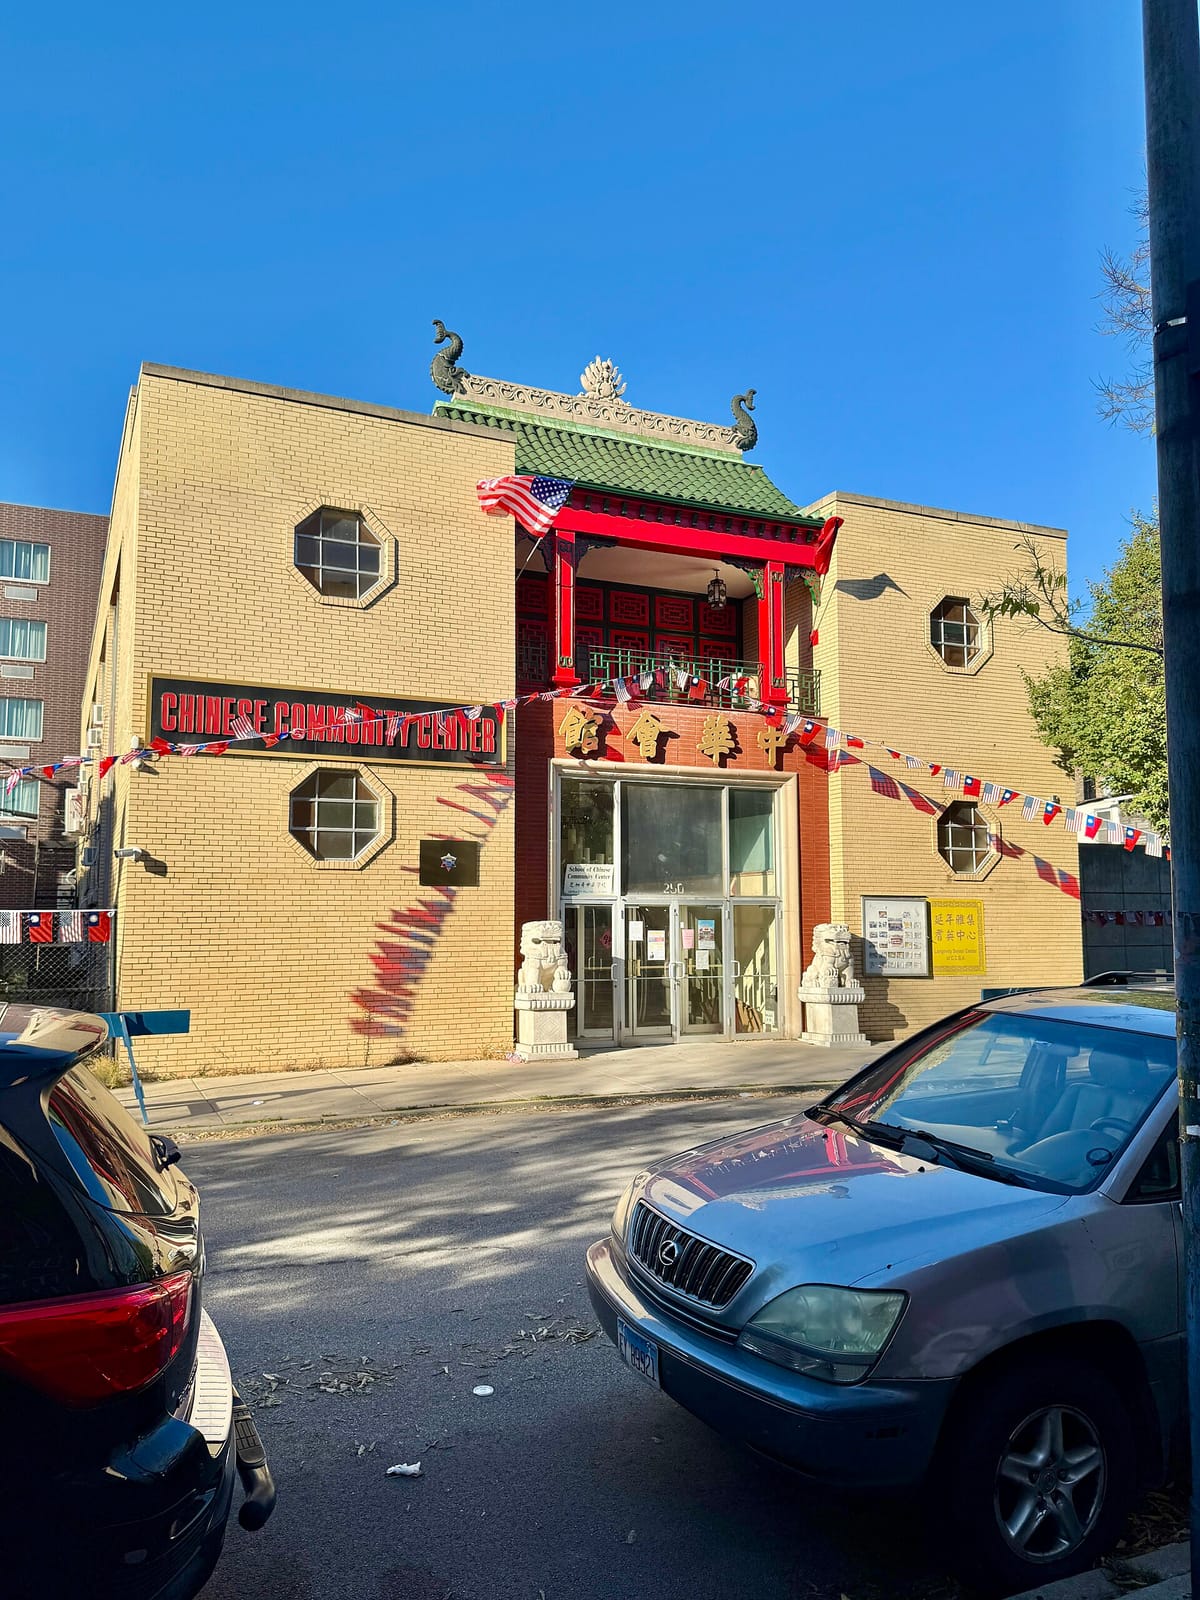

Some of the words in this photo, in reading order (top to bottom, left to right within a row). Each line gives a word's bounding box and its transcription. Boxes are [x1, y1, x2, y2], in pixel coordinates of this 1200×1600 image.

[161, 692, 268, 737] CHINESE
[274, 701, 411, 748] COMMUNITY
[663, 882, 685, 894] 250
